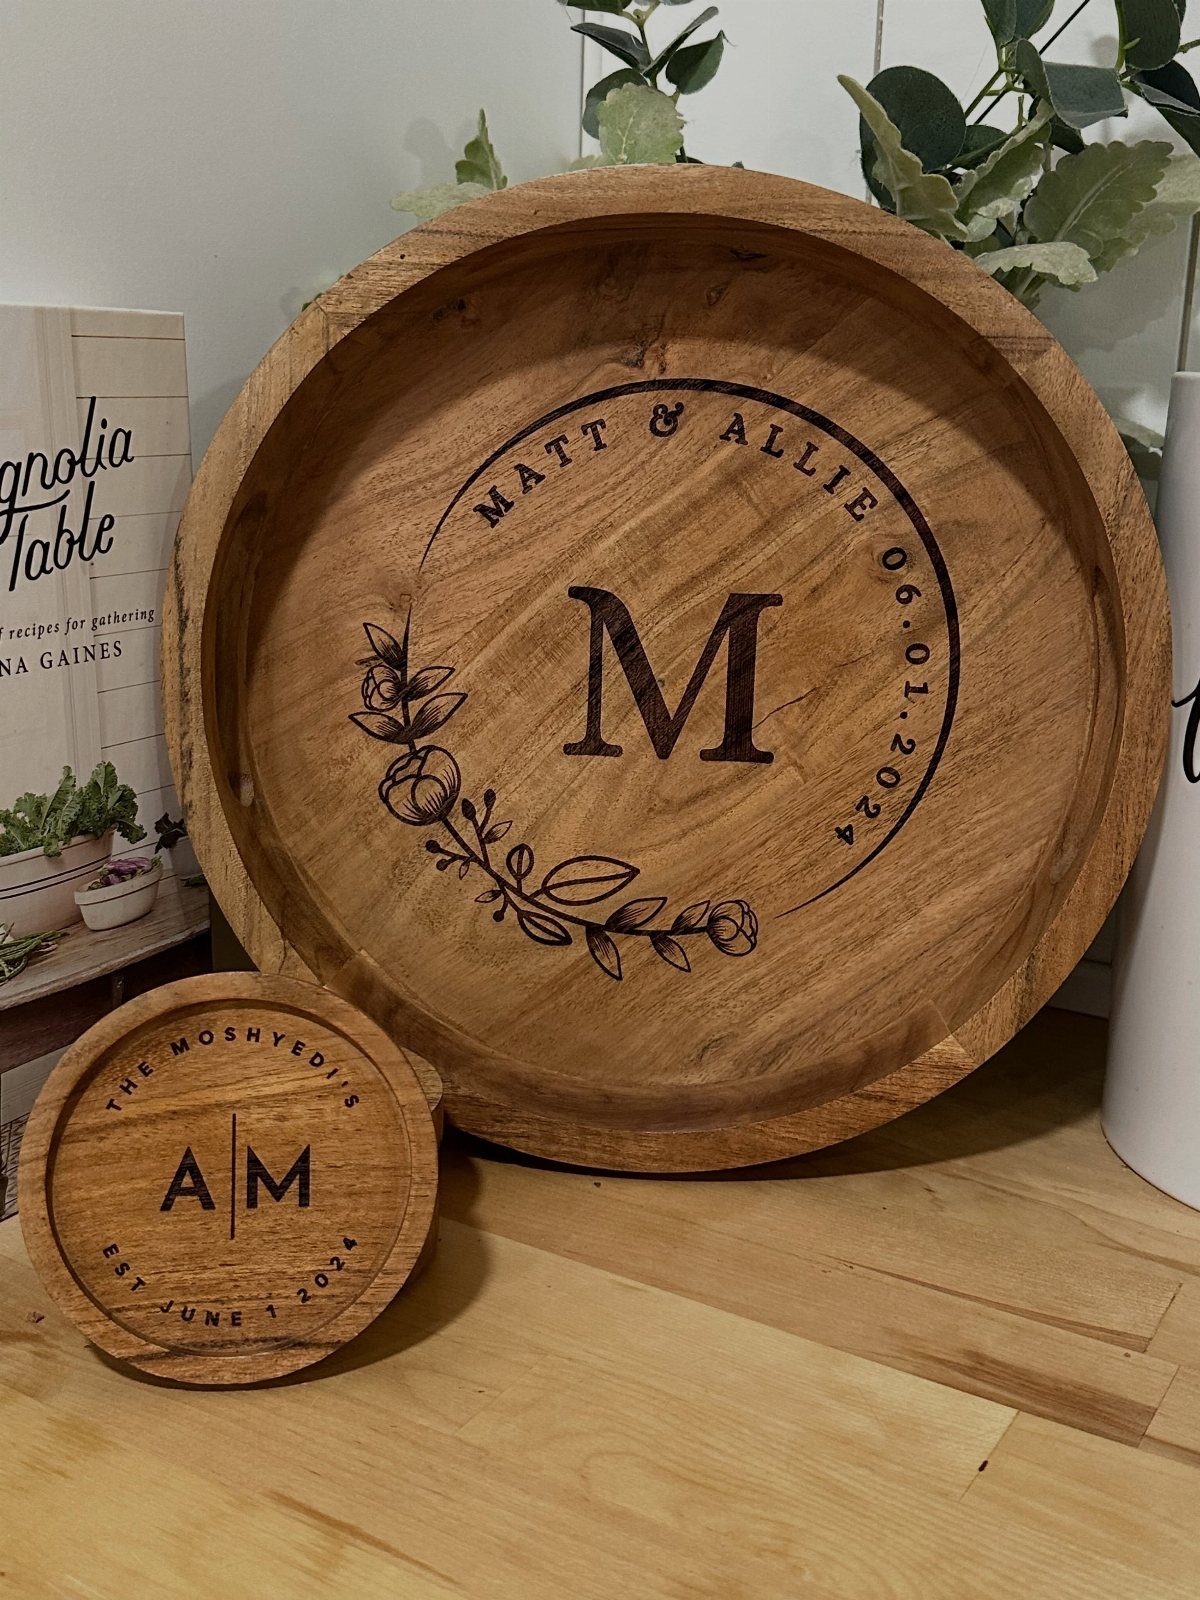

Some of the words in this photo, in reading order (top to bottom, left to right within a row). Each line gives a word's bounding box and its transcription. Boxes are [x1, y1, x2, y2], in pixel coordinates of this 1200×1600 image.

[472, 418, 607, 528] MATT
[649, 401, 685, 437] &
[719, 412, 879, 522] ALLIE
[8, 480, 115, 592] Table
[9, 622, 60, 640] recipes
[64, 617, 86, 636] for
[91, 608, 155, 632] gathering
[40, 640, 122, 670] GAINES
[562, 585, 784, 764] M
[834, 545, 931, 846] 06.01.2024
[106, 1060, 154, 1113] THE
[170, 1026, 360, 1109] MOSHYEDI'S
[102, 1242, 146, 1294] EST
[159, 1299, 242, 1328] JUNE
[265, 1303, 278, 1320] 1
[296, 1235, 359, 1303] 2024
